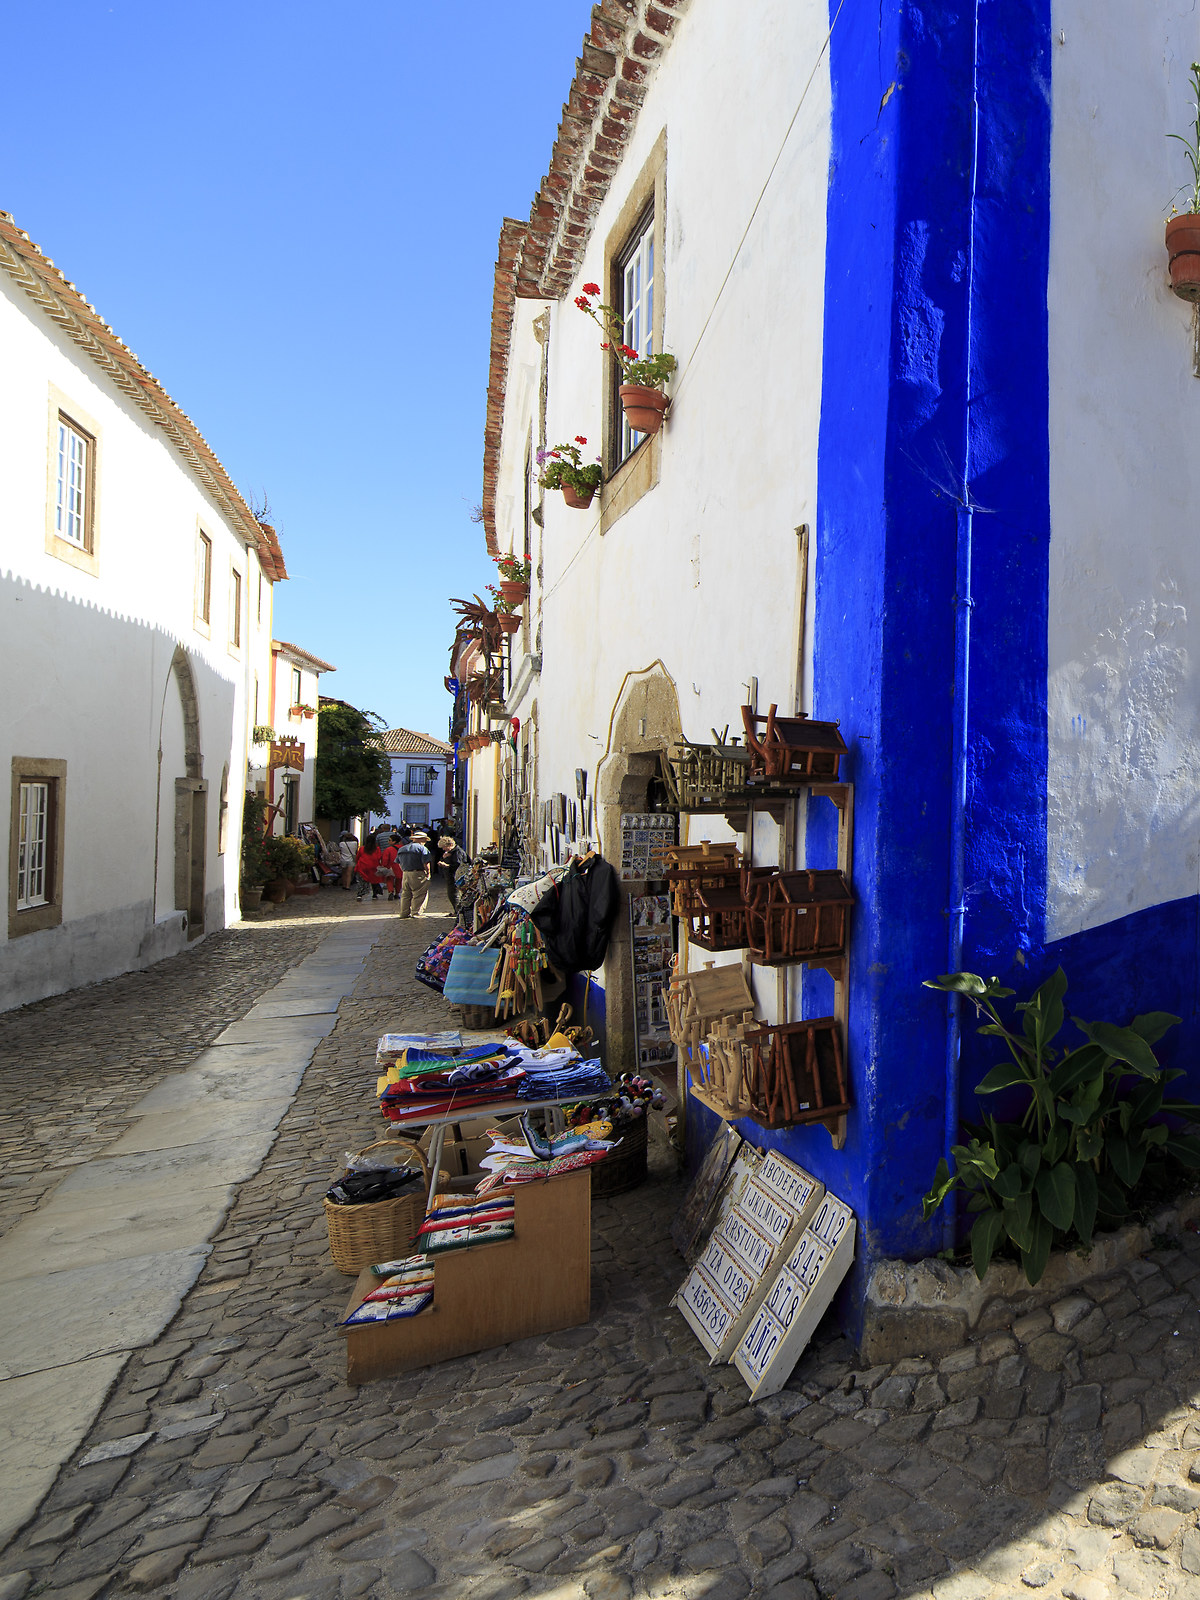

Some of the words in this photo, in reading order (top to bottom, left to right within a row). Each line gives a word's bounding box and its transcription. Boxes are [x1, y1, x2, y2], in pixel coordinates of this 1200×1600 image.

[272, 749, 302, 764] BAR
[760, 1159, 810, 1206] ABCDEFGH
[743, 1187, 789, 1236] IJKLMNOP
[725, 1215, 770, 1269] QRSTUVWX
[723, 1265, 749, 1303] 0123
